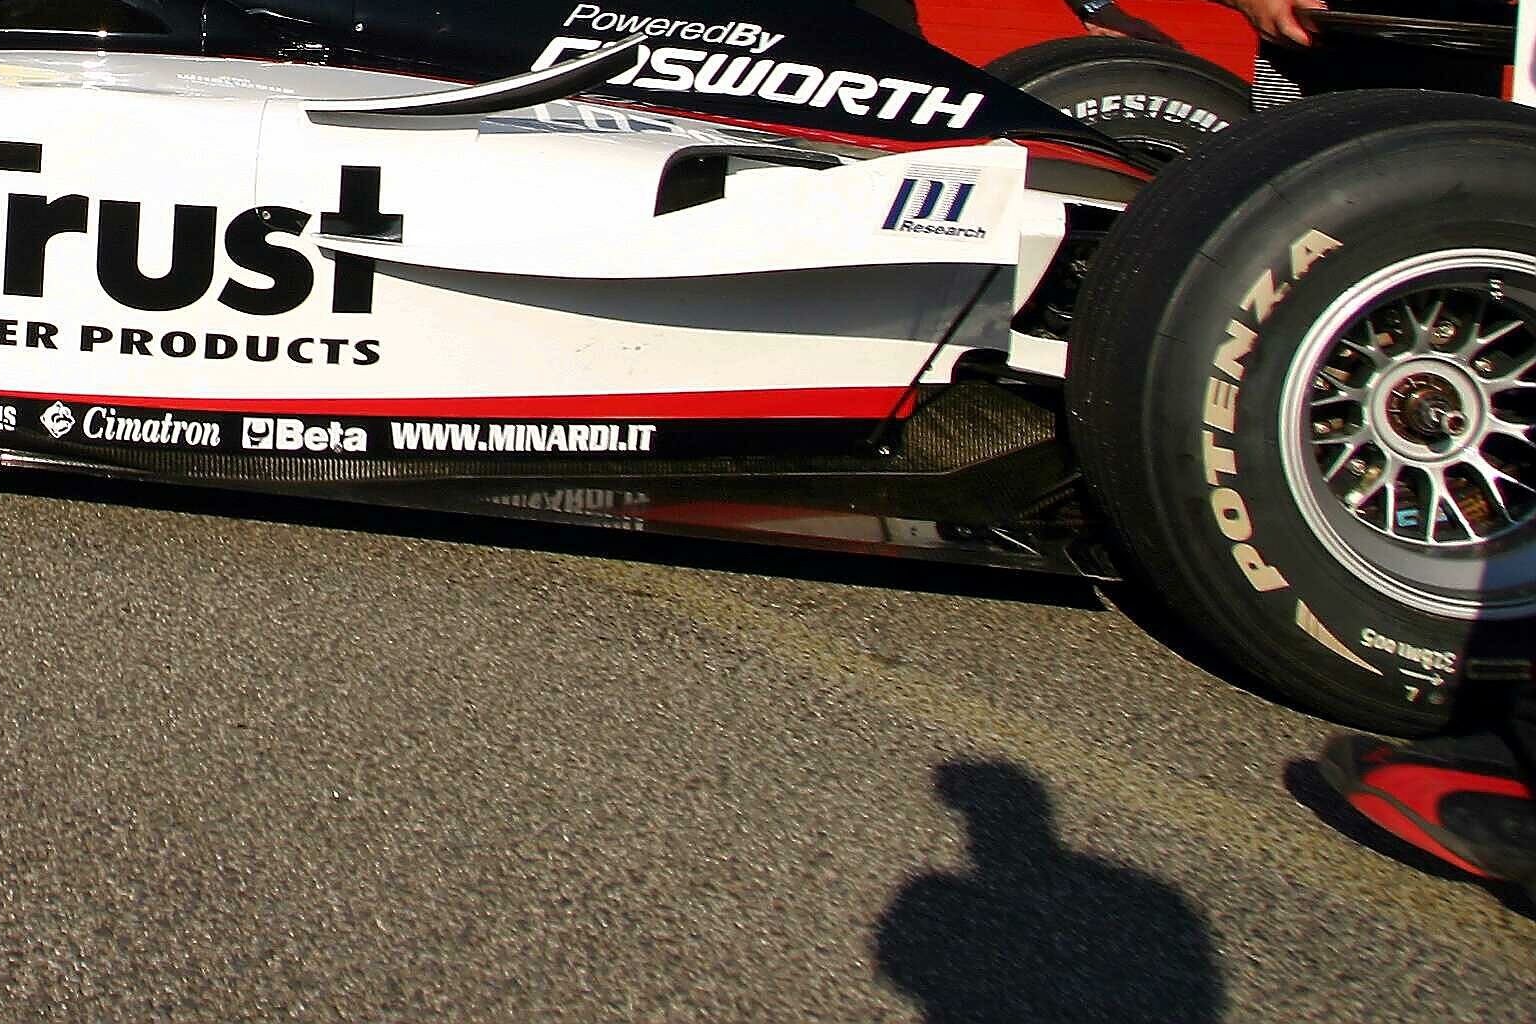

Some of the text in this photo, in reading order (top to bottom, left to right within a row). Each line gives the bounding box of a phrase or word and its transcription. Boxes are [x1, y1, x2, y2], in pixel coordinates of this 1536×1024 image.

[900, 220, 986, 239] Research
[80, 324, 381, 366] PRODUCTS
[83, 407, 220, 446] Cimatron
[1202, 229, 1344, 592] POTENZA
[276, 419, 367, 452] Beta
[391, 422, 656, 452] WWW.MINARDI.IT
